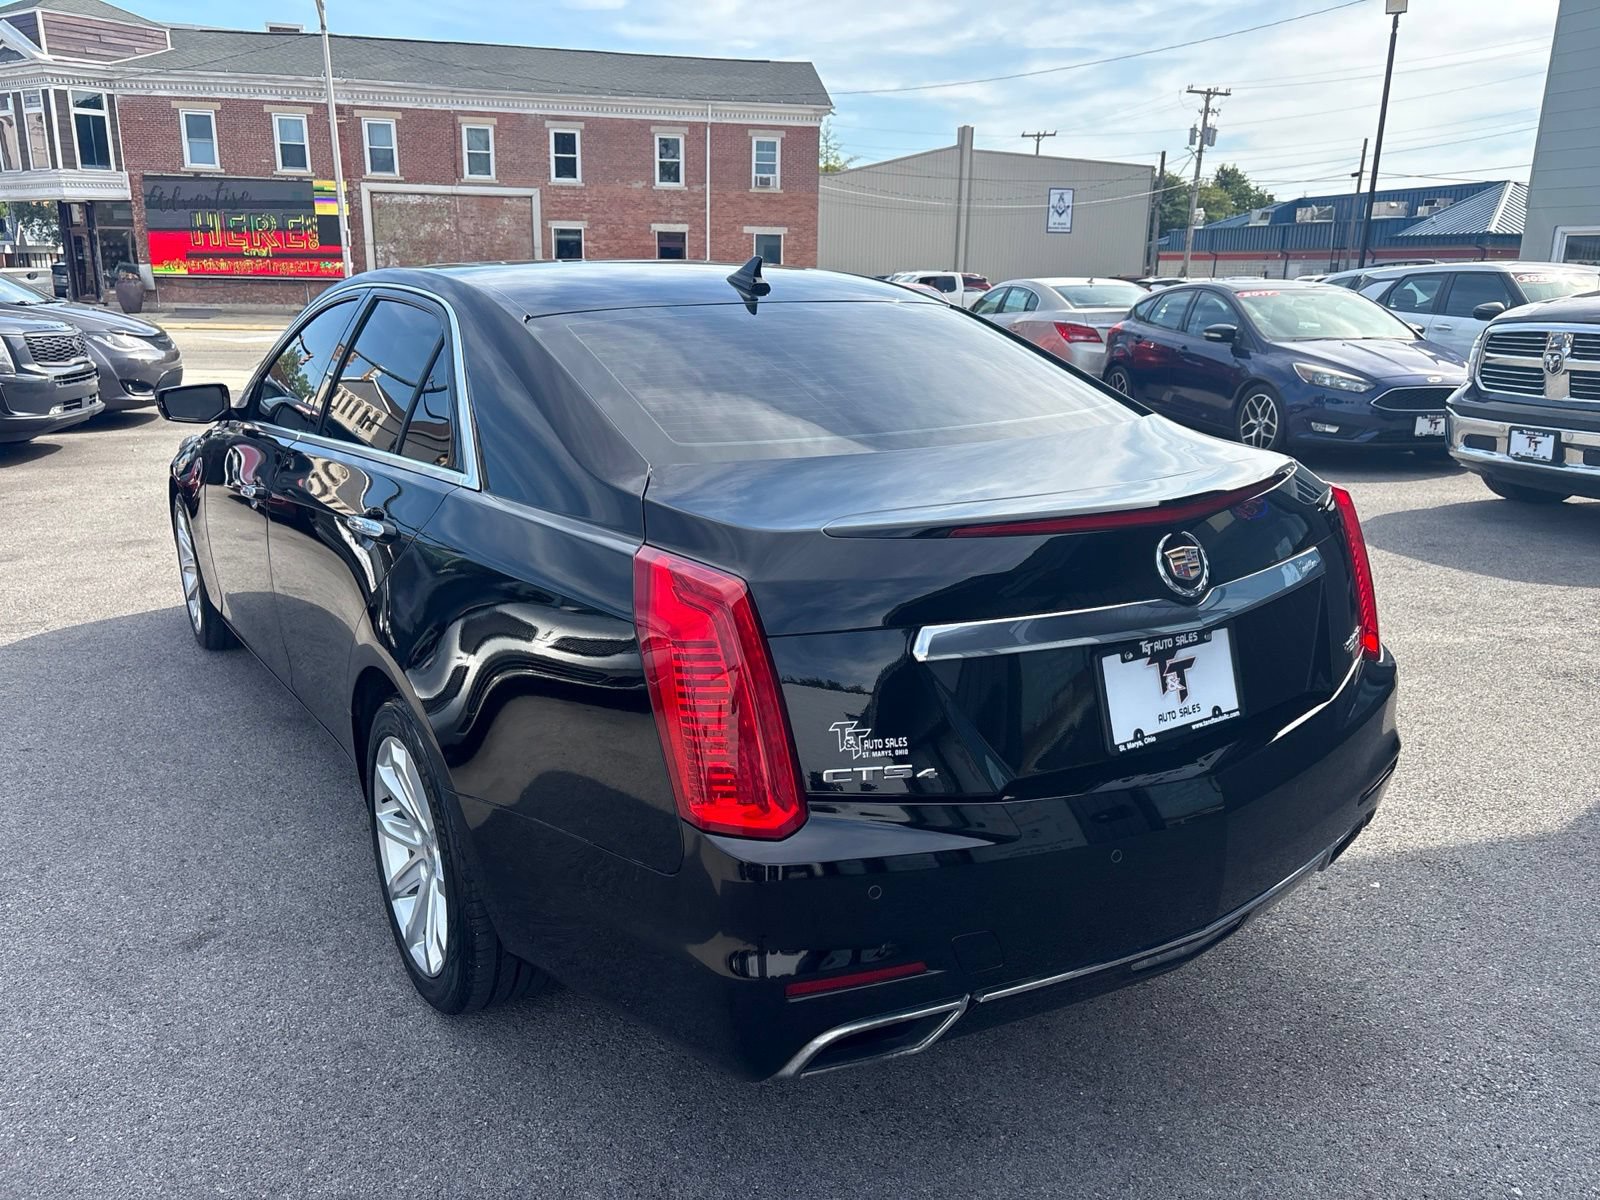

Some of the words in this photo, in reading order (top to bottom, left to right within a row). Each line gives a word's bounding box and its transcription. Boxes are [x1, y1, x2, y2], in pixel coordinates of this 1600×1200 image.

[190, 211, 320, 250] HERE!
[1153, 639, 1174, 652] AUTO
[1175, 632, 1198, 645] SALES
[1158, 710, 1177, 724] AUTO
[1179, 703, 1202, 718] SALES
[828, 720, 872, 760] T&T
[863, 739, 883, 751] AUTO
[884, 736, 908, 748] SALES
[823, 764, 913, 783] CTS
